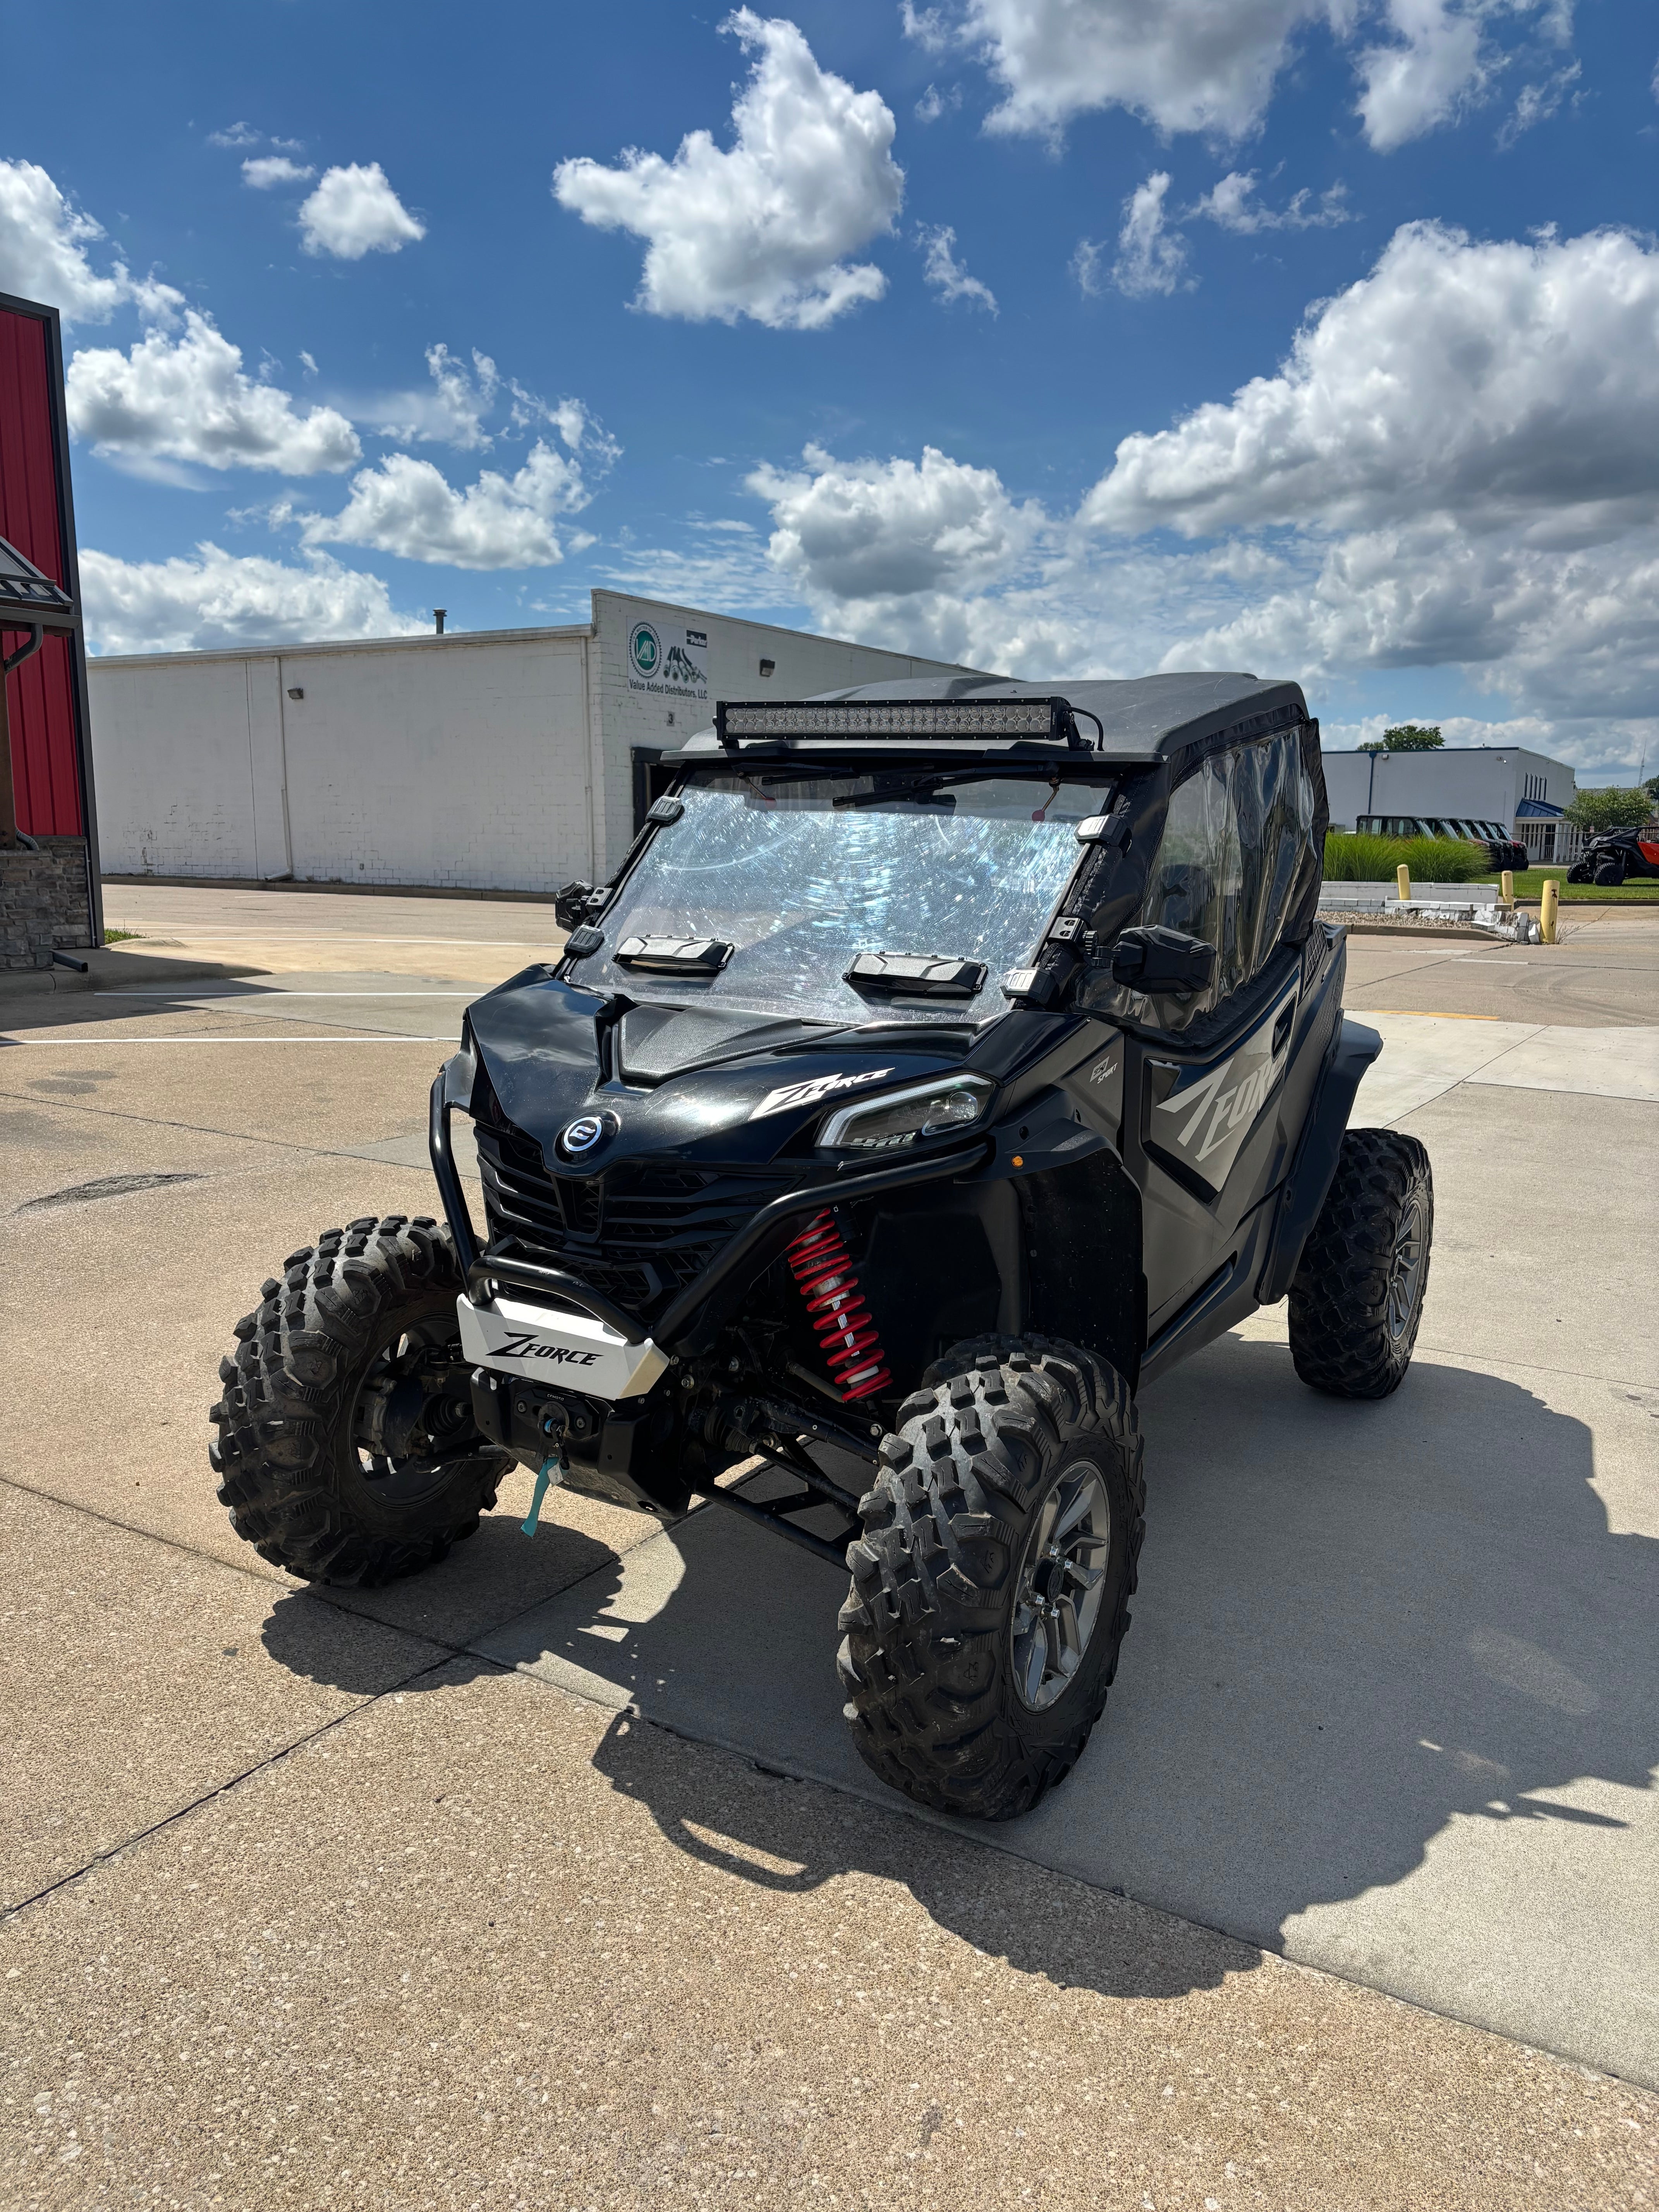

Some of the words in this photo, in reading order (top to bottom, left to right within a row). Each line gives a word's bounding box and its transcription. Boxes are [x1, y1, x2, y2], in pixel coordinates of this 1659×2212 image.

[629, 679, 645, 691] Value
[646, 682, 664, 694] Added
[665, 684, 697, 699] Distributors,
[698, 689, 708, 699] LLC
[668, 714, 673, 724] 3
[1097, 1062, 1118, 1084] SPORT
